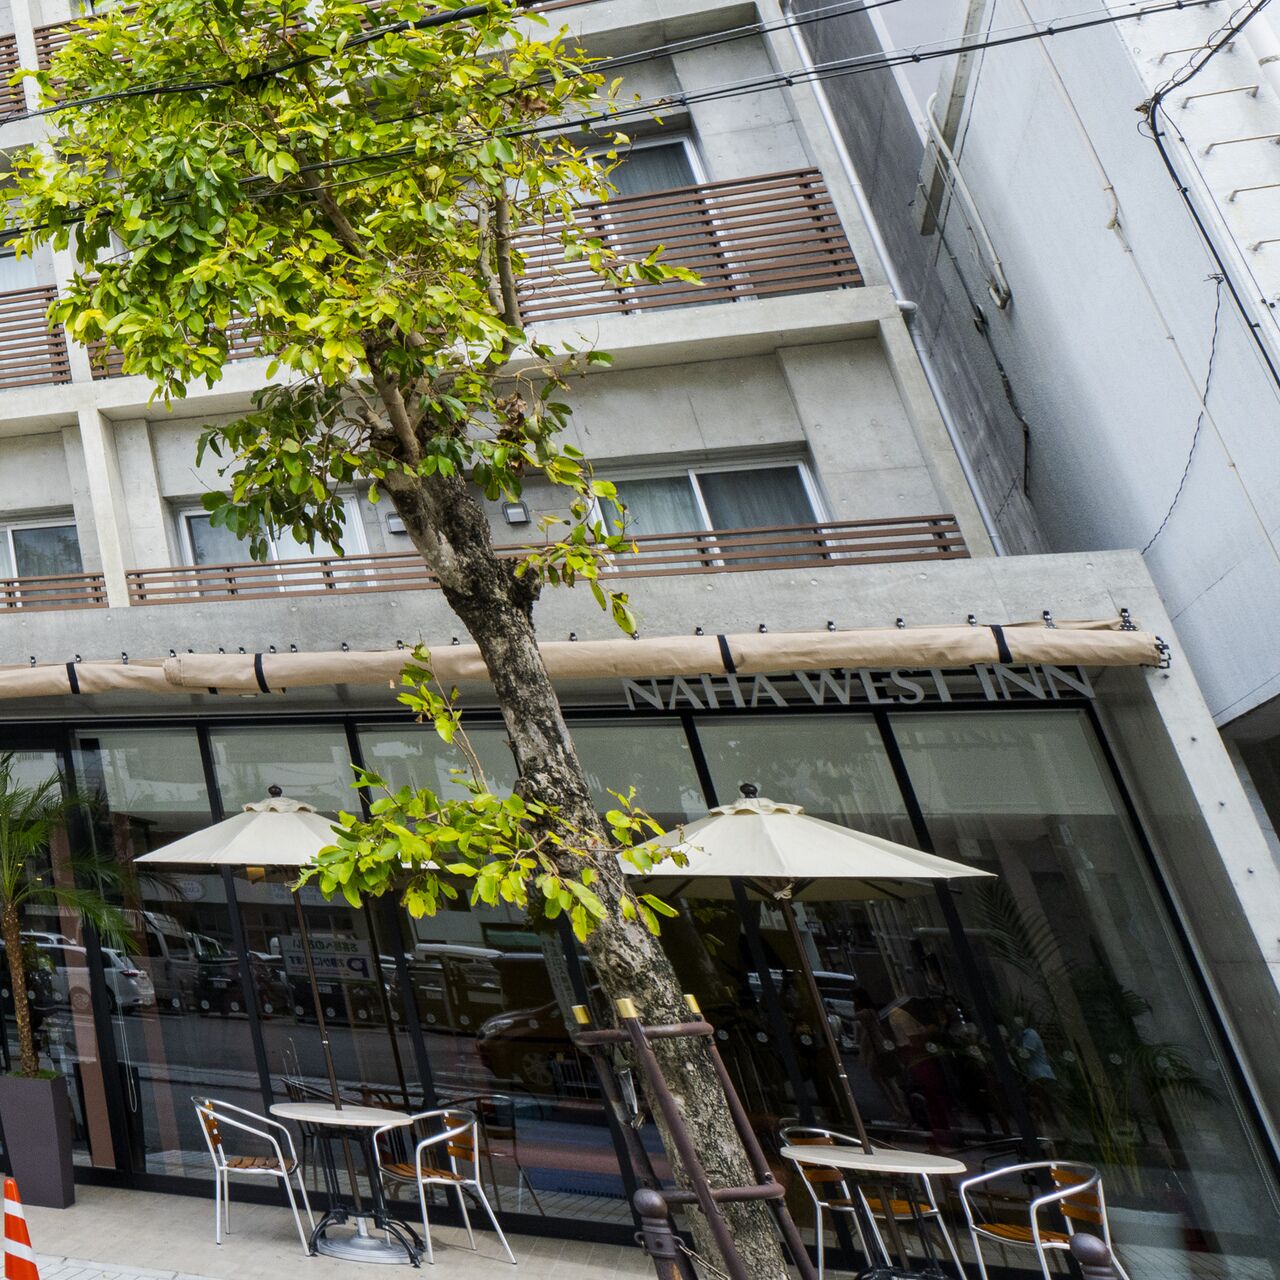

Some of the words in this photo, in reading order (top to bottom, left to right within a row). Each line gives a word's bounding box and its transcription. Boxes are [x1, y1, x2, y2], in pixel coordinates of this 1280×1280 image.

[620, 671, 790, 711] NAHA
[794, 668, 954, 706] WEST
[974, 663, 1096, 702] INN
